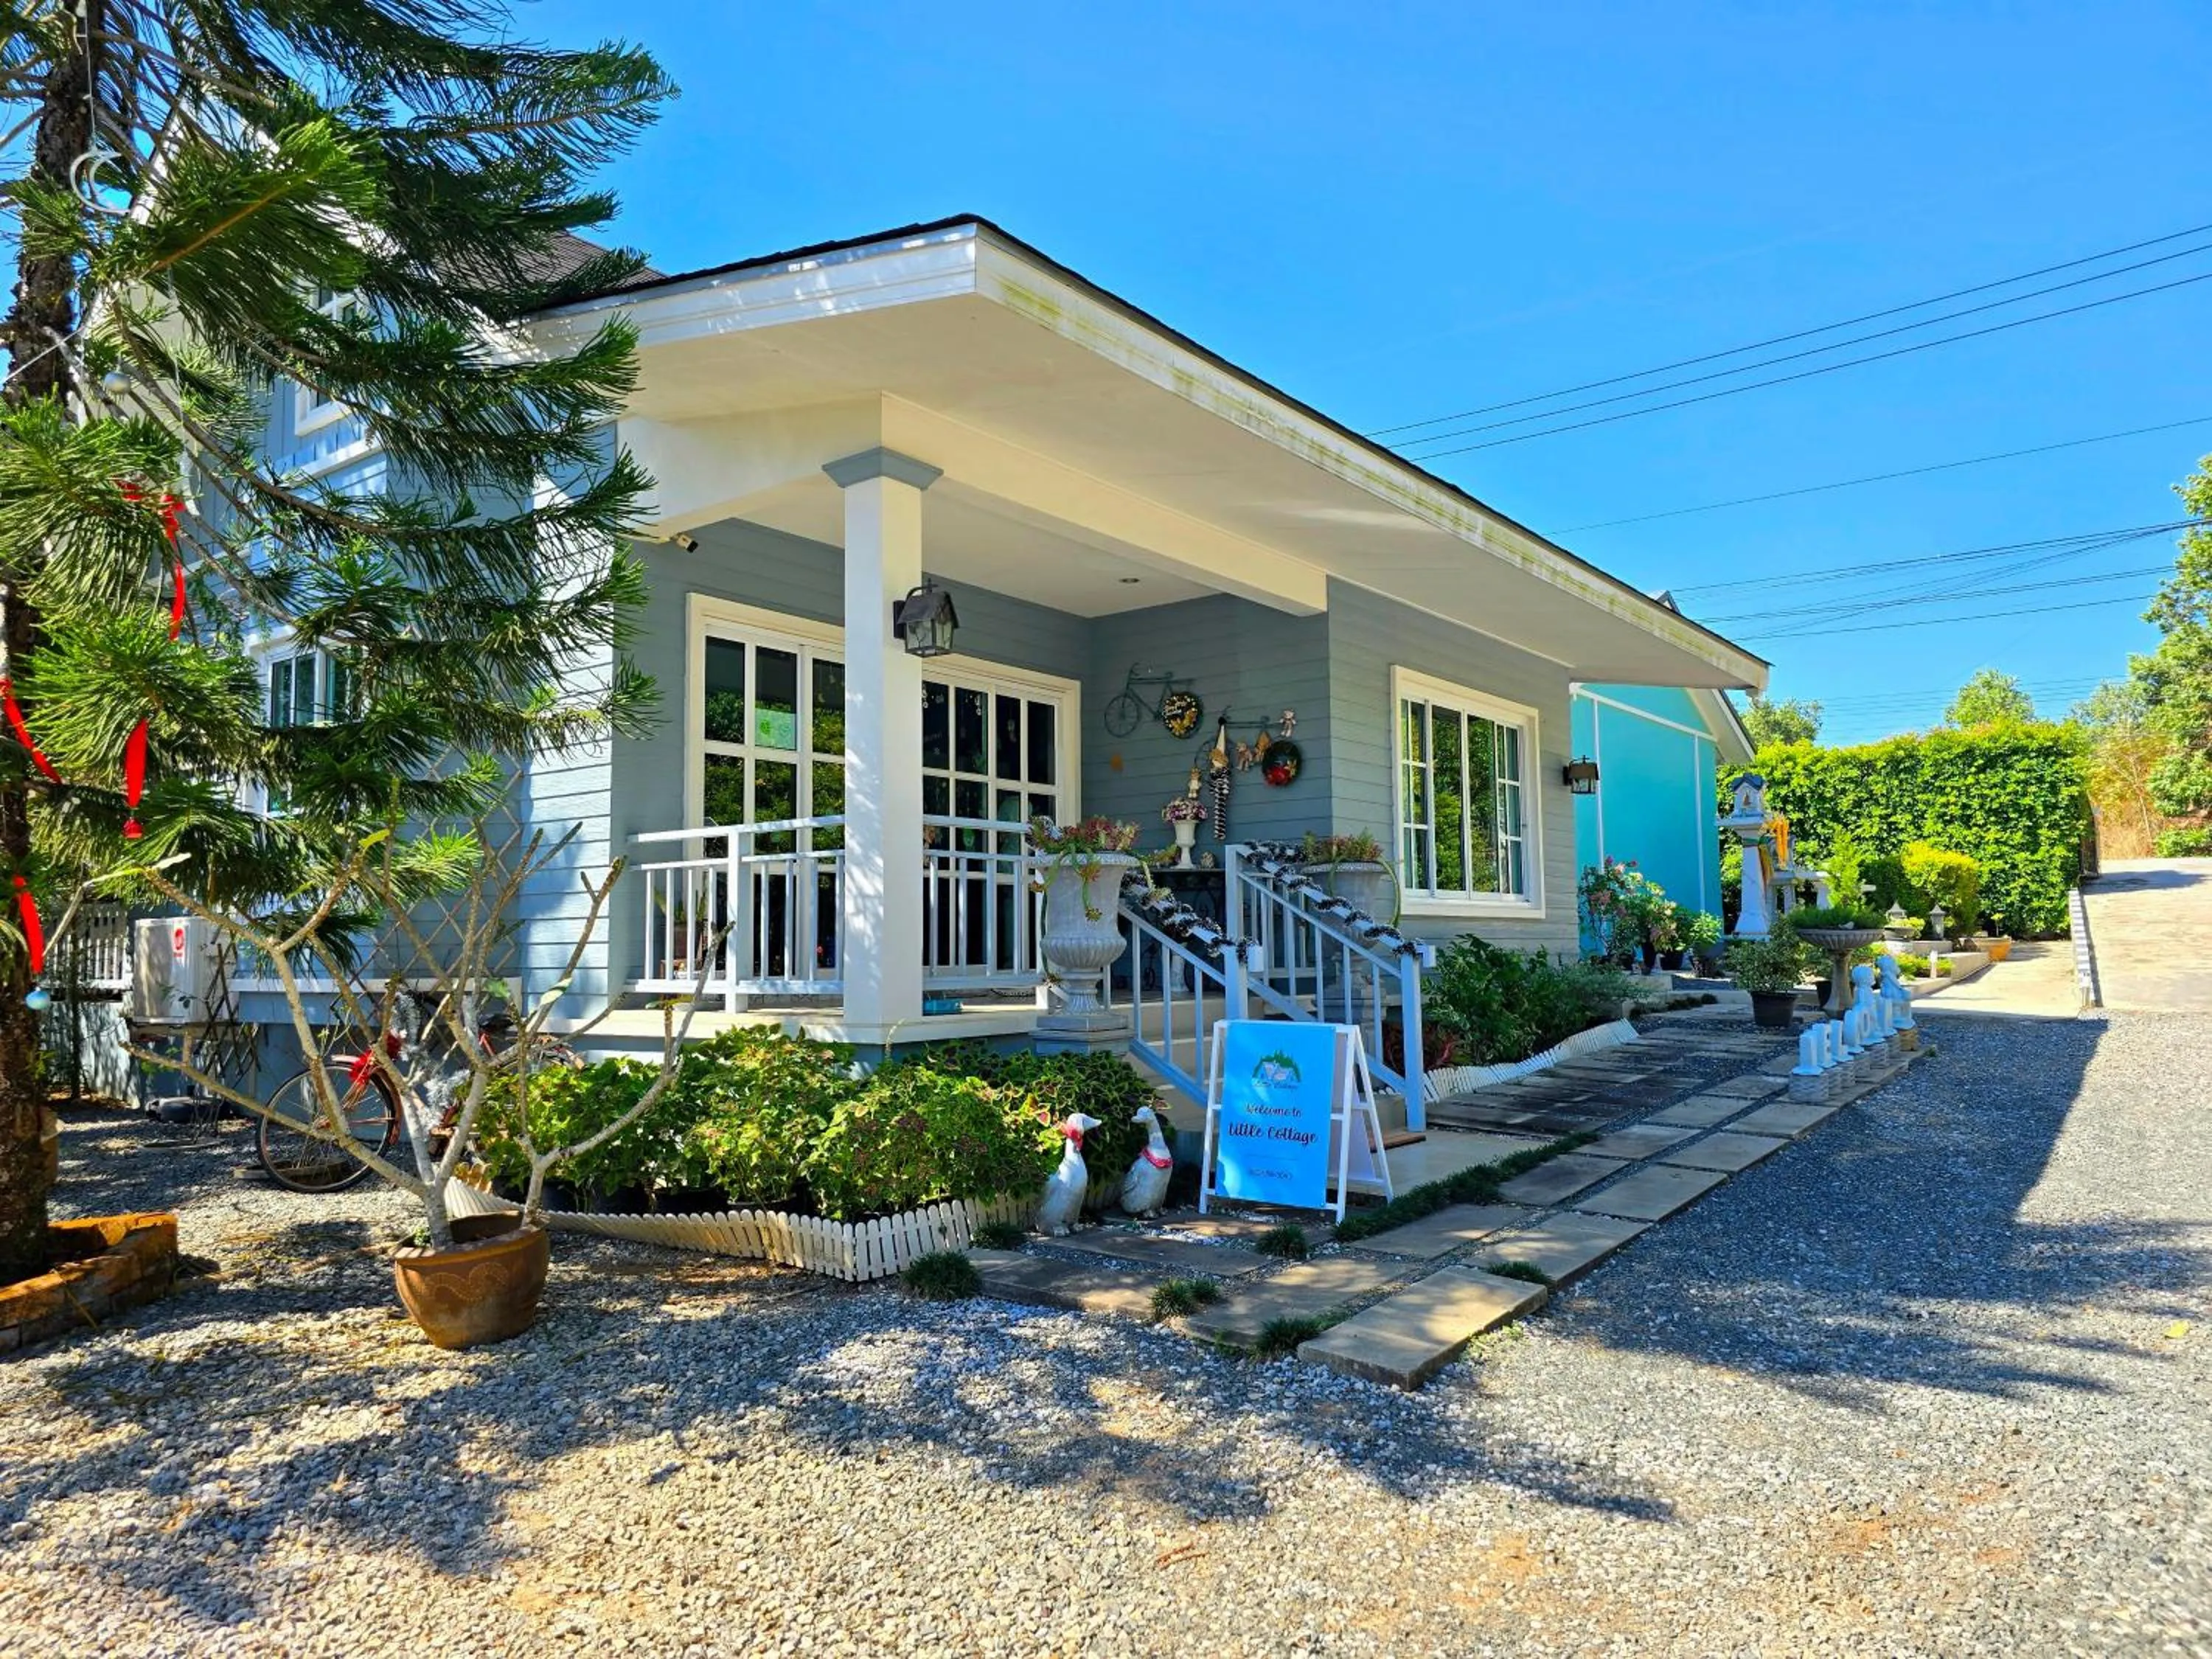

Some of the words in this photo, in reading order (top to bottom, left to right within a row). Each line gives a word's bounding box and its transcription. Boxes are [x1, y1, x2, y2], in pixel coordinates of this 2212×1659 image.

[1245, 1103, 1290, 1116] Welcome
[1292, 1106, 1301, 1118] to
[1267, 1126, 1318, 1146] Cottage
